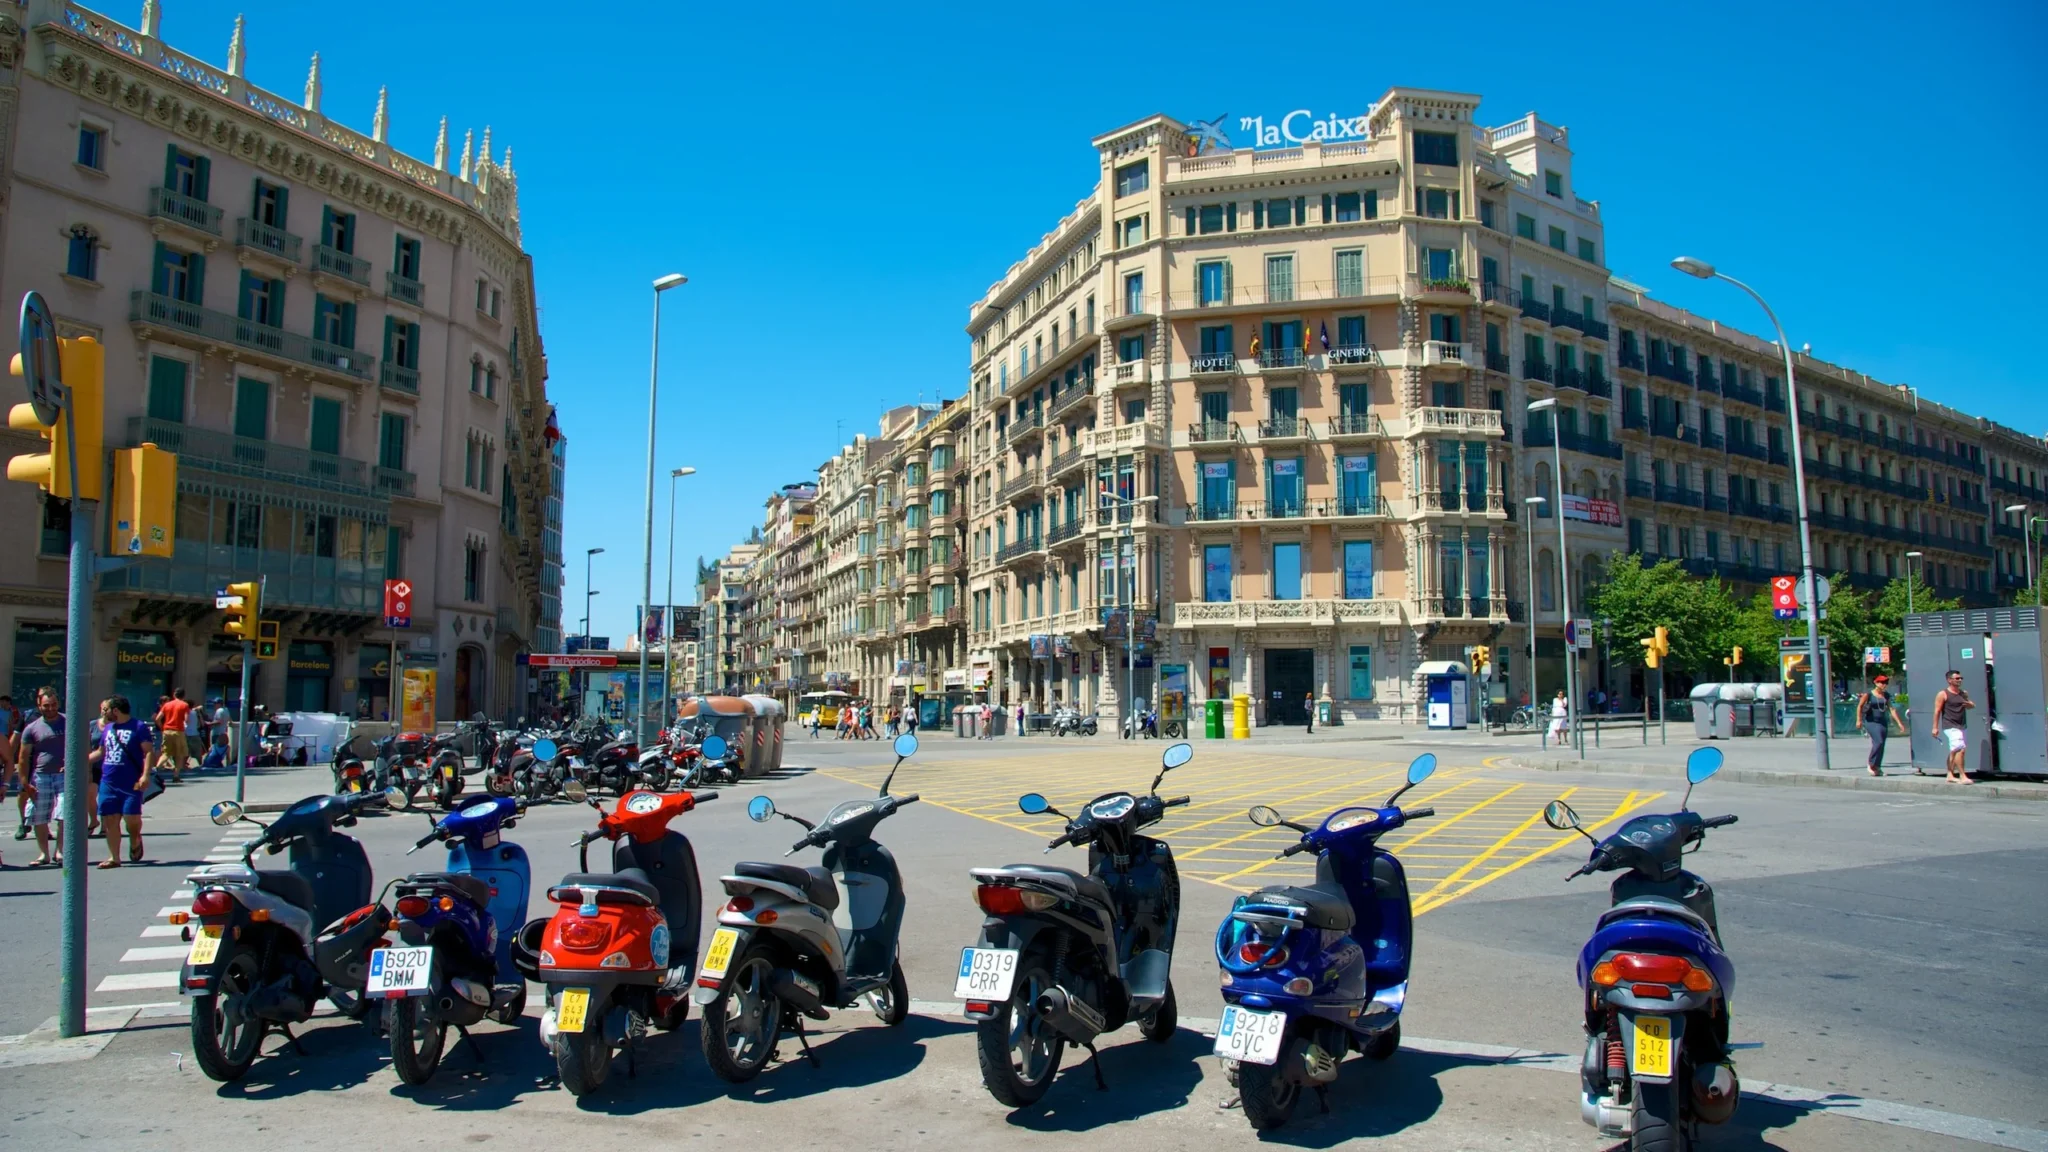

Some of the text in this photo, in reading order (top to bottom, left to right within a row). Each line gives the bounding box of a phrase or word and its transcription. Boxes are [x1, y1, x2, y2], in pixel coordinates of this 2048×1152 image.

[1328, 347, 1373, 359] GINEBRA
[1195, 358, 1230, 368] HOTEL
[118, 651, 175, 666] iberCaja
[291, 660, 331, 669] Barcelona
[1263, 897, 1289, 906] PIAGGIO
[385, 950, 427, 968] 6920
[974, 952, 1013, 972] 0319
[383, 970, 414, 987] BMM
[970, 973, 999, 990] CRR
[1236, 1012, 1278, 1035] 9218
[1231, 1032, 1265, 1053] GVC
[1640, 1039, 1664, 1051] 512
[1640, 1053, 1663, 1066] BST
